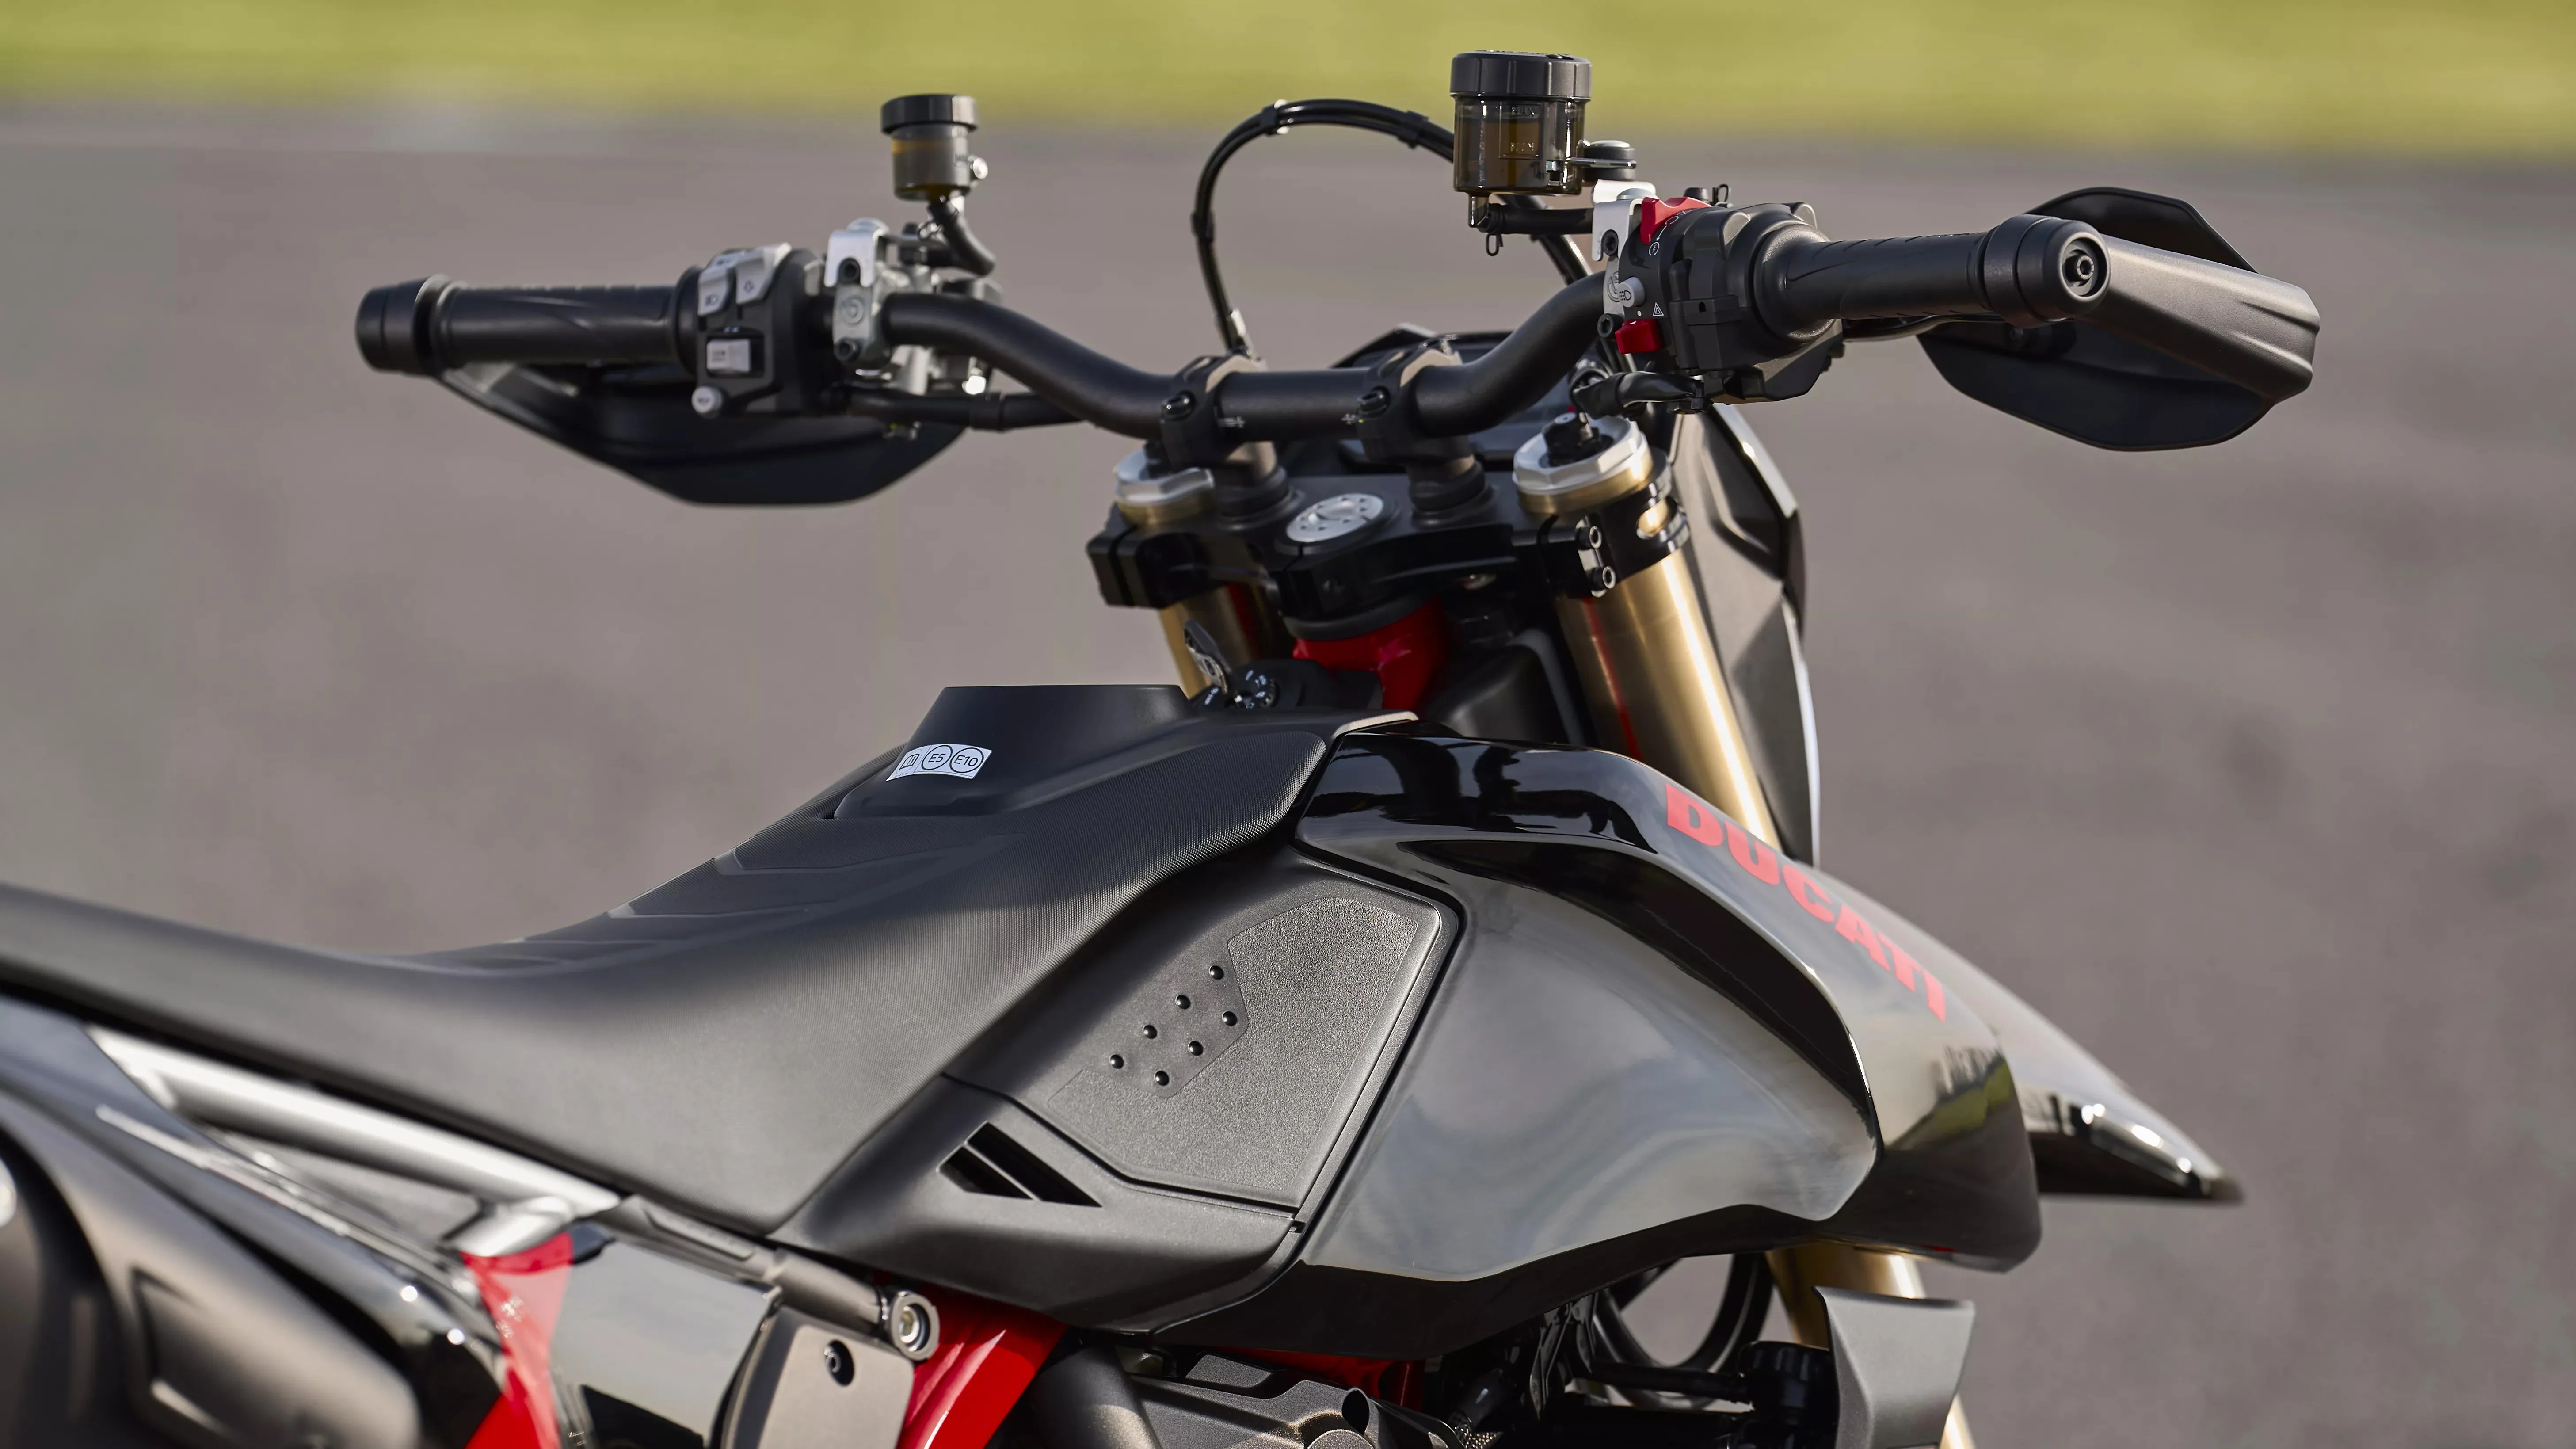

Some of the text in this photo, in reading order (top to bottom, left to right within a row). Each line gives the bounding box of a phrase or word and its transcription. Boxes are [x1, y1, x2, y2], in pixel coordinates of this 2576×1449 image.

[928, 753, 979, 767] E5 E10
[1665, 783, 1945, 1023] DUCATI
